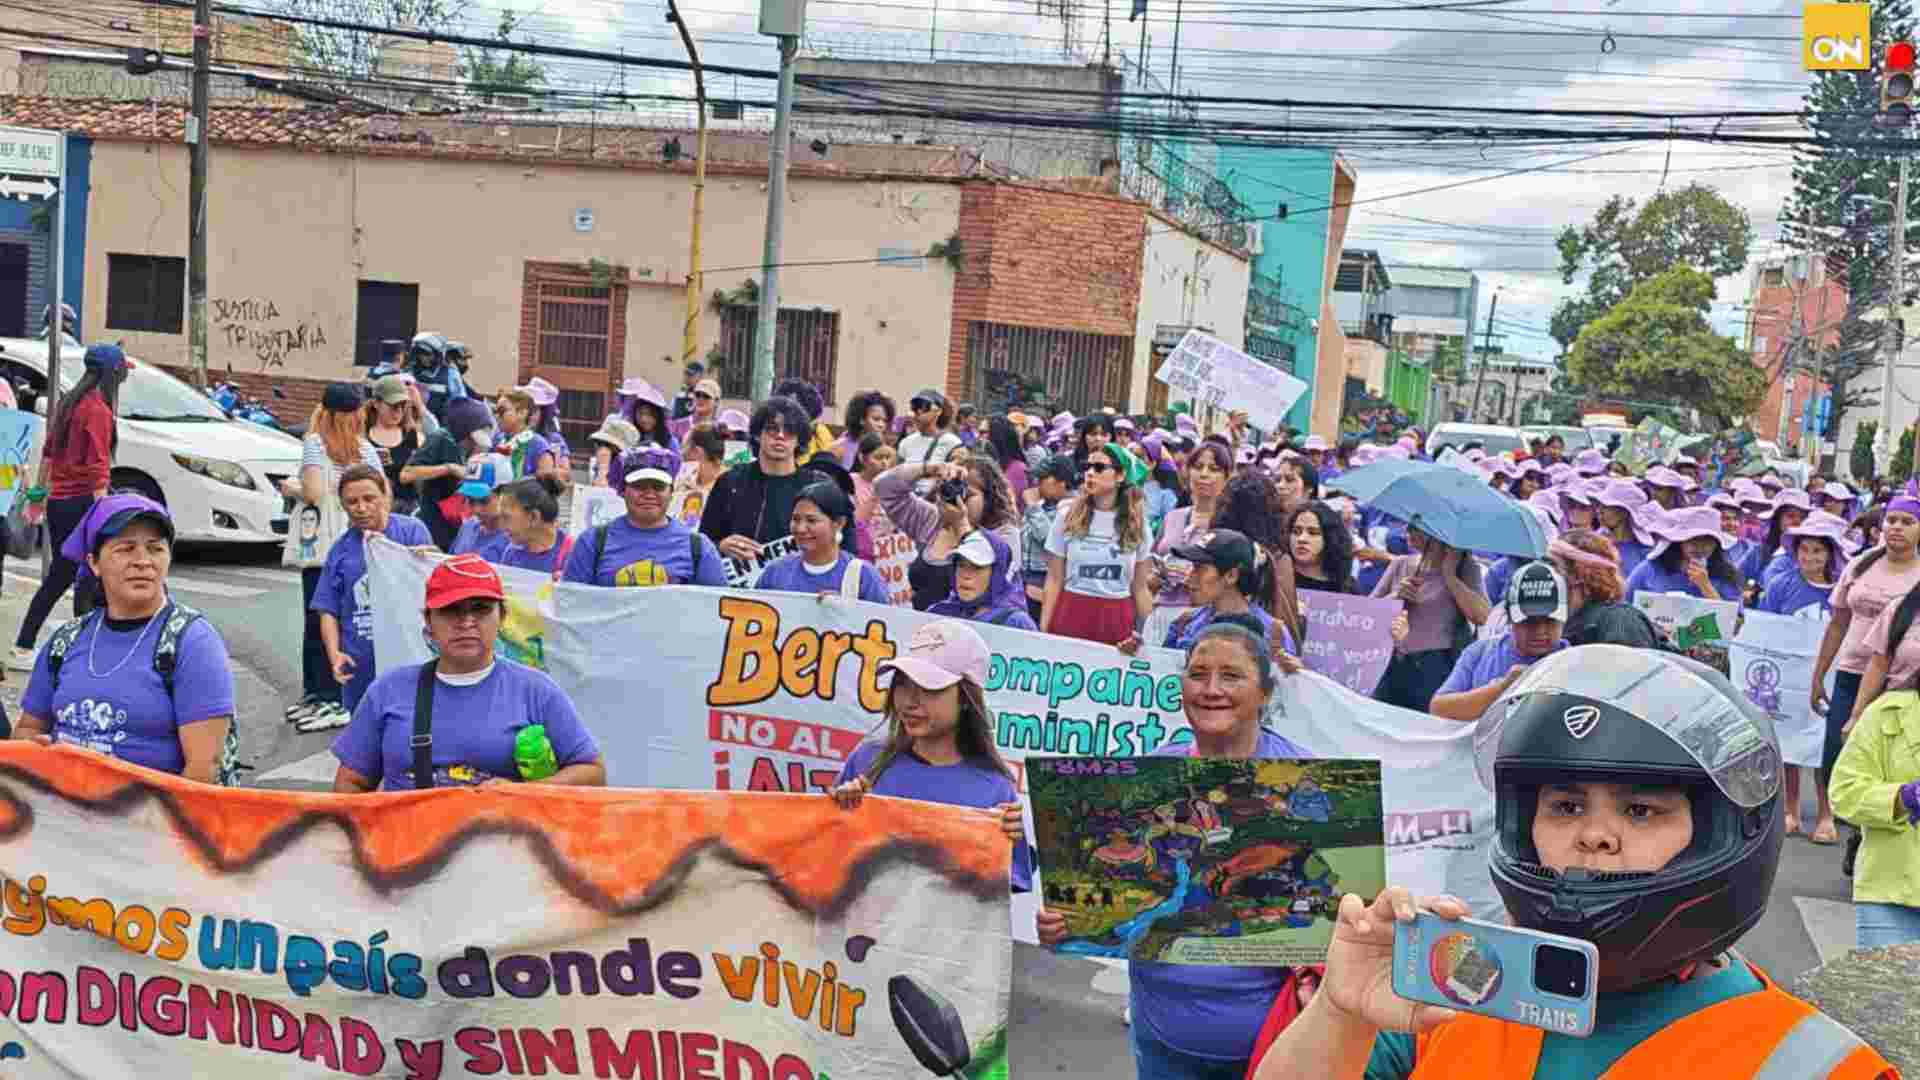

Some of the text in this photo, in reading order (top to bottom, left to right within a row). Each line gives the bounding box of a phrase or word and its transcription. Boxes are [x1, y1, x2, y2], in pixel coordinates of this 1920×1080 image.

[211, 299, 281, 322] JUSTICIA
[707, 596, 898, 715] Bert
[983, 653, 1184, 713] ompañe
[719, 713, 834, 755] NO AL
[995, 711, 1196, 760] minist
[198, 914, 279, 975] un
[282, 930, 428, 999] país
[436, 937, 702, 999] donde
[711, 941, 866, 1037] vivir
[76, 965, 386, 1076] DIGNIDAD
[395, 1036, 444, 1080] y
[454, 1025, 580, 1078] SIN
